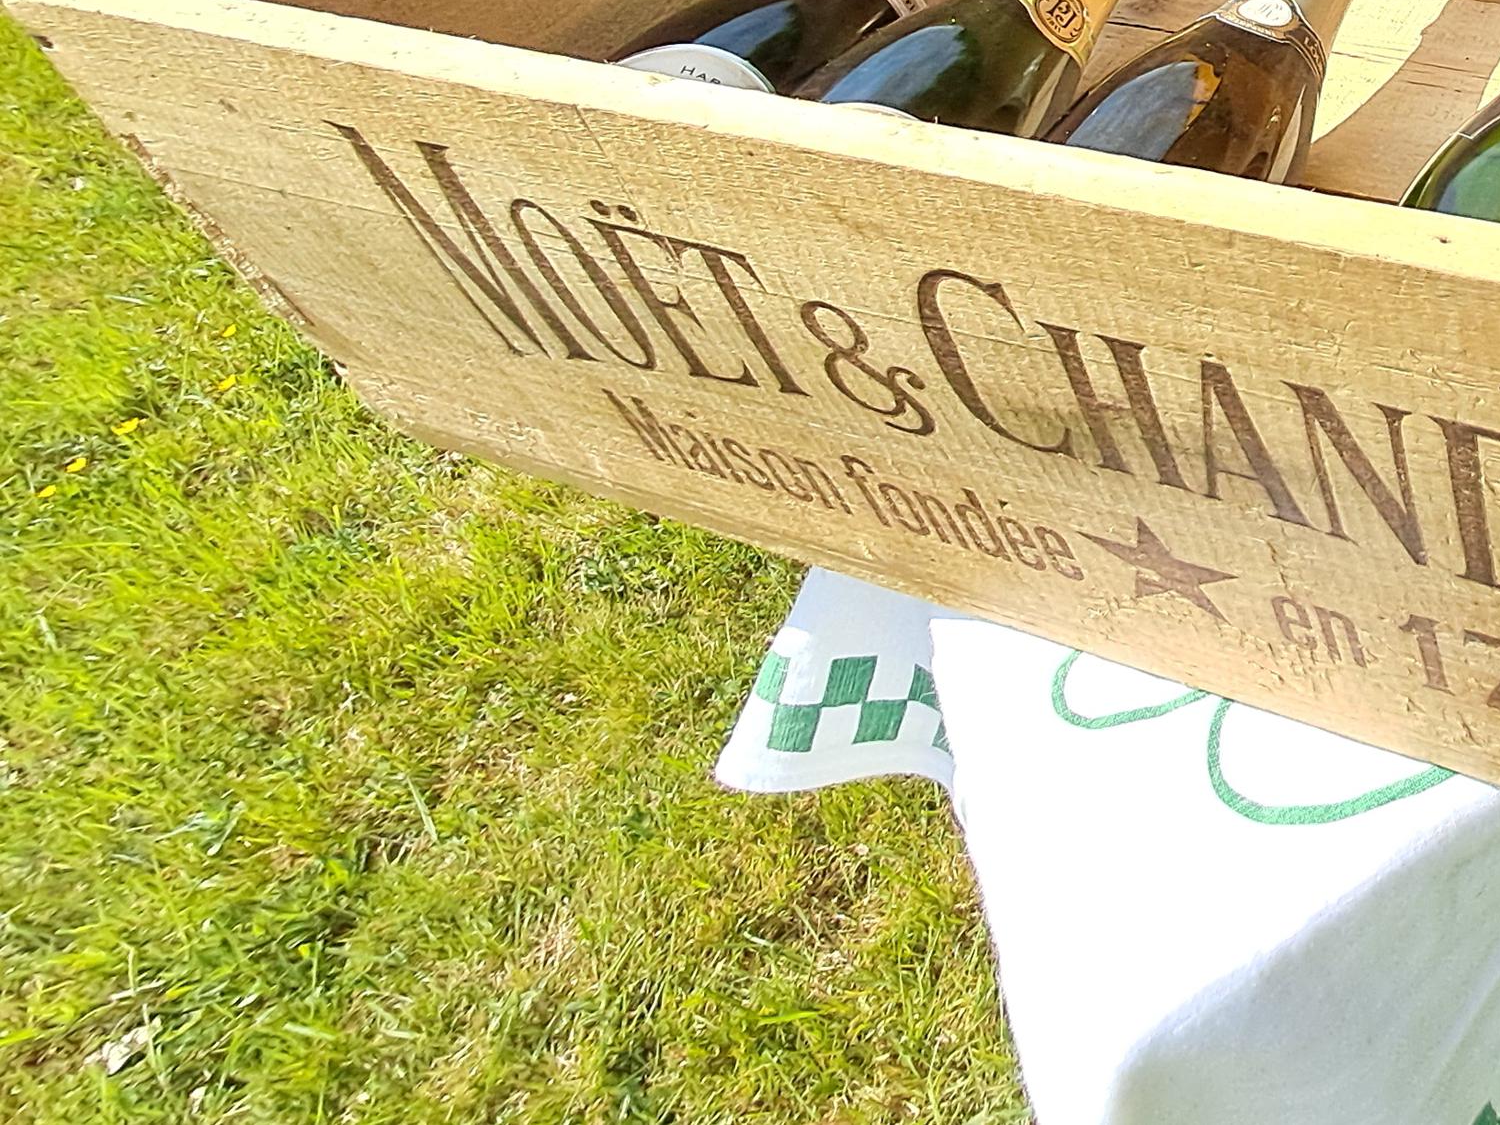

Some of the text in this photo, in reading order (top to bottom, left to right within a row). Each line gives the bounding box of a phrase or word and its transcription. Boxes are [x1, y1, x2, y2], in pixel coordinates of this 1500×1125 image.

[800, 299, 937, 437] &
[601, 387, 850, 512] Maison
[843, 453, 1086, 582] fondée
[1271, 592, 1365, 669] en
